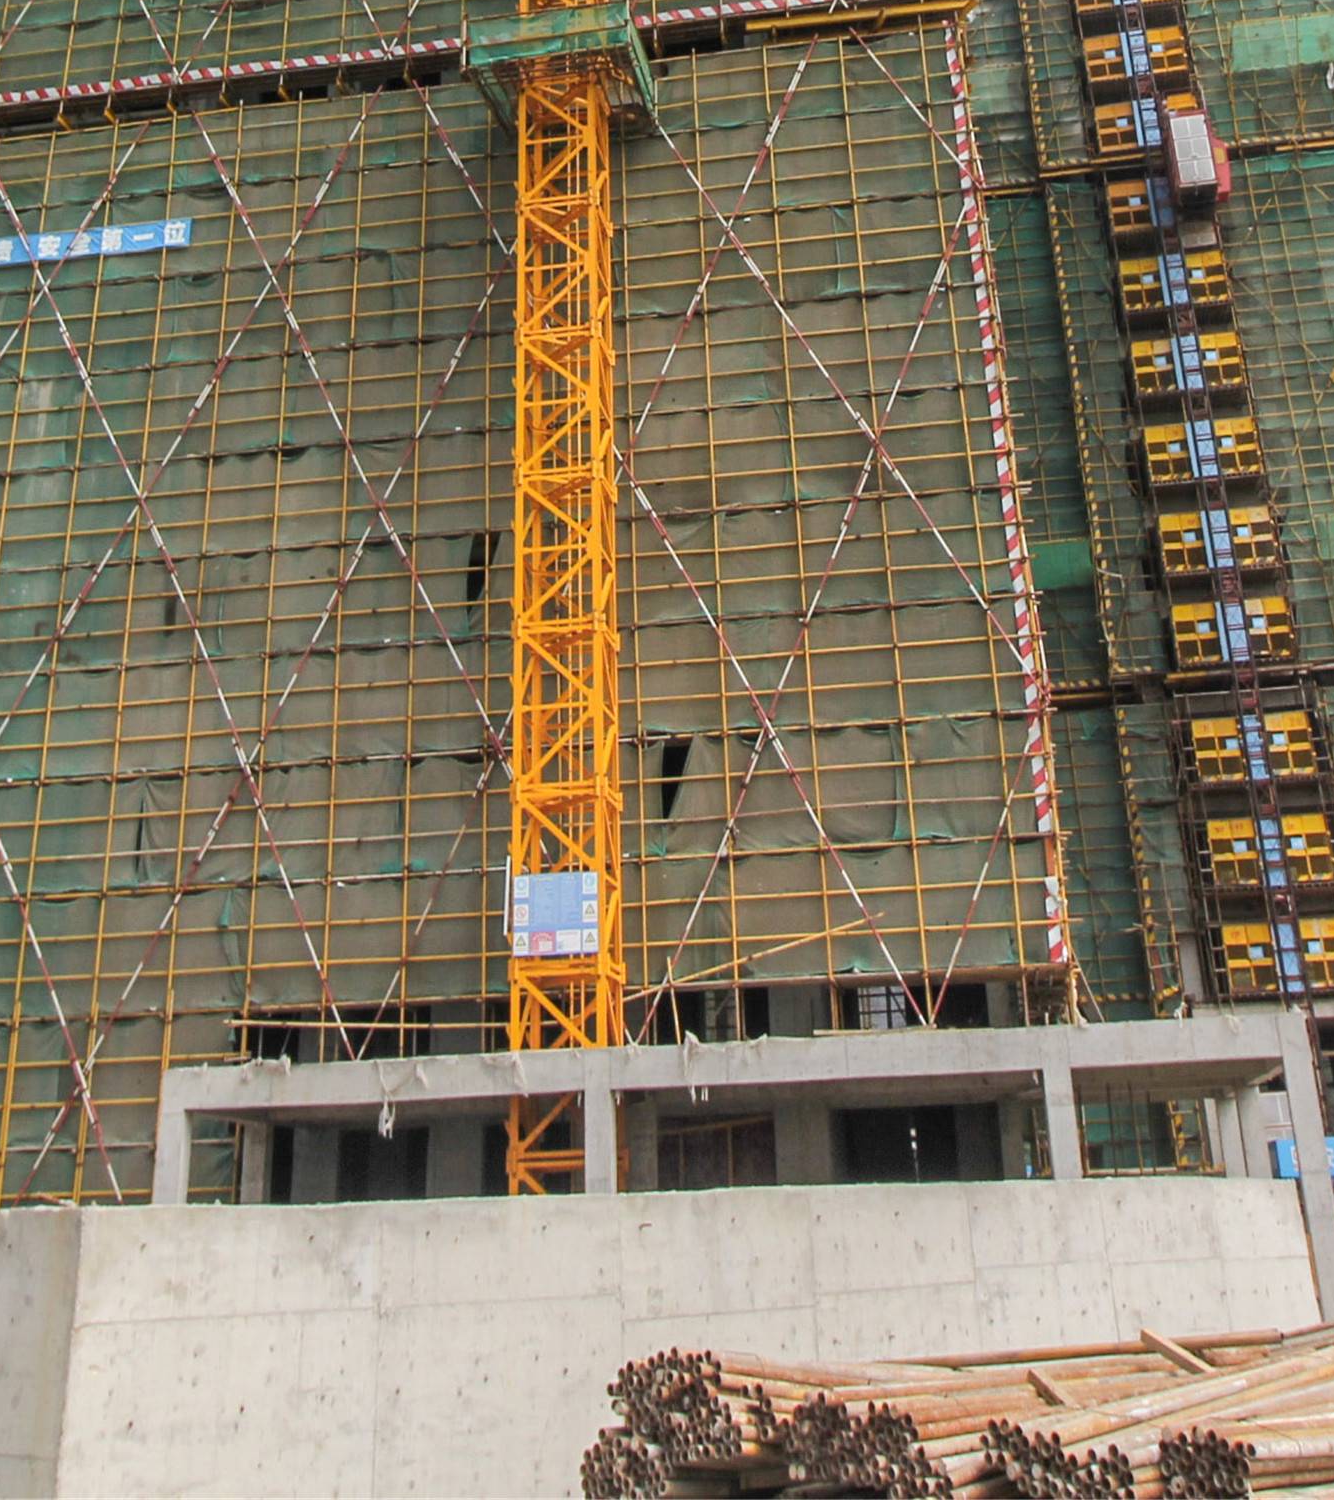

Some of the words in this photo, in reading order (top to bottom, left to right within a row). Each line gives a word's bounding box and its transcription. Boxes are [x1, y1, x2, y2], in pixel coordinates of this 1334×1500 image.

[38, 221, 188, 258] 安全第一位
